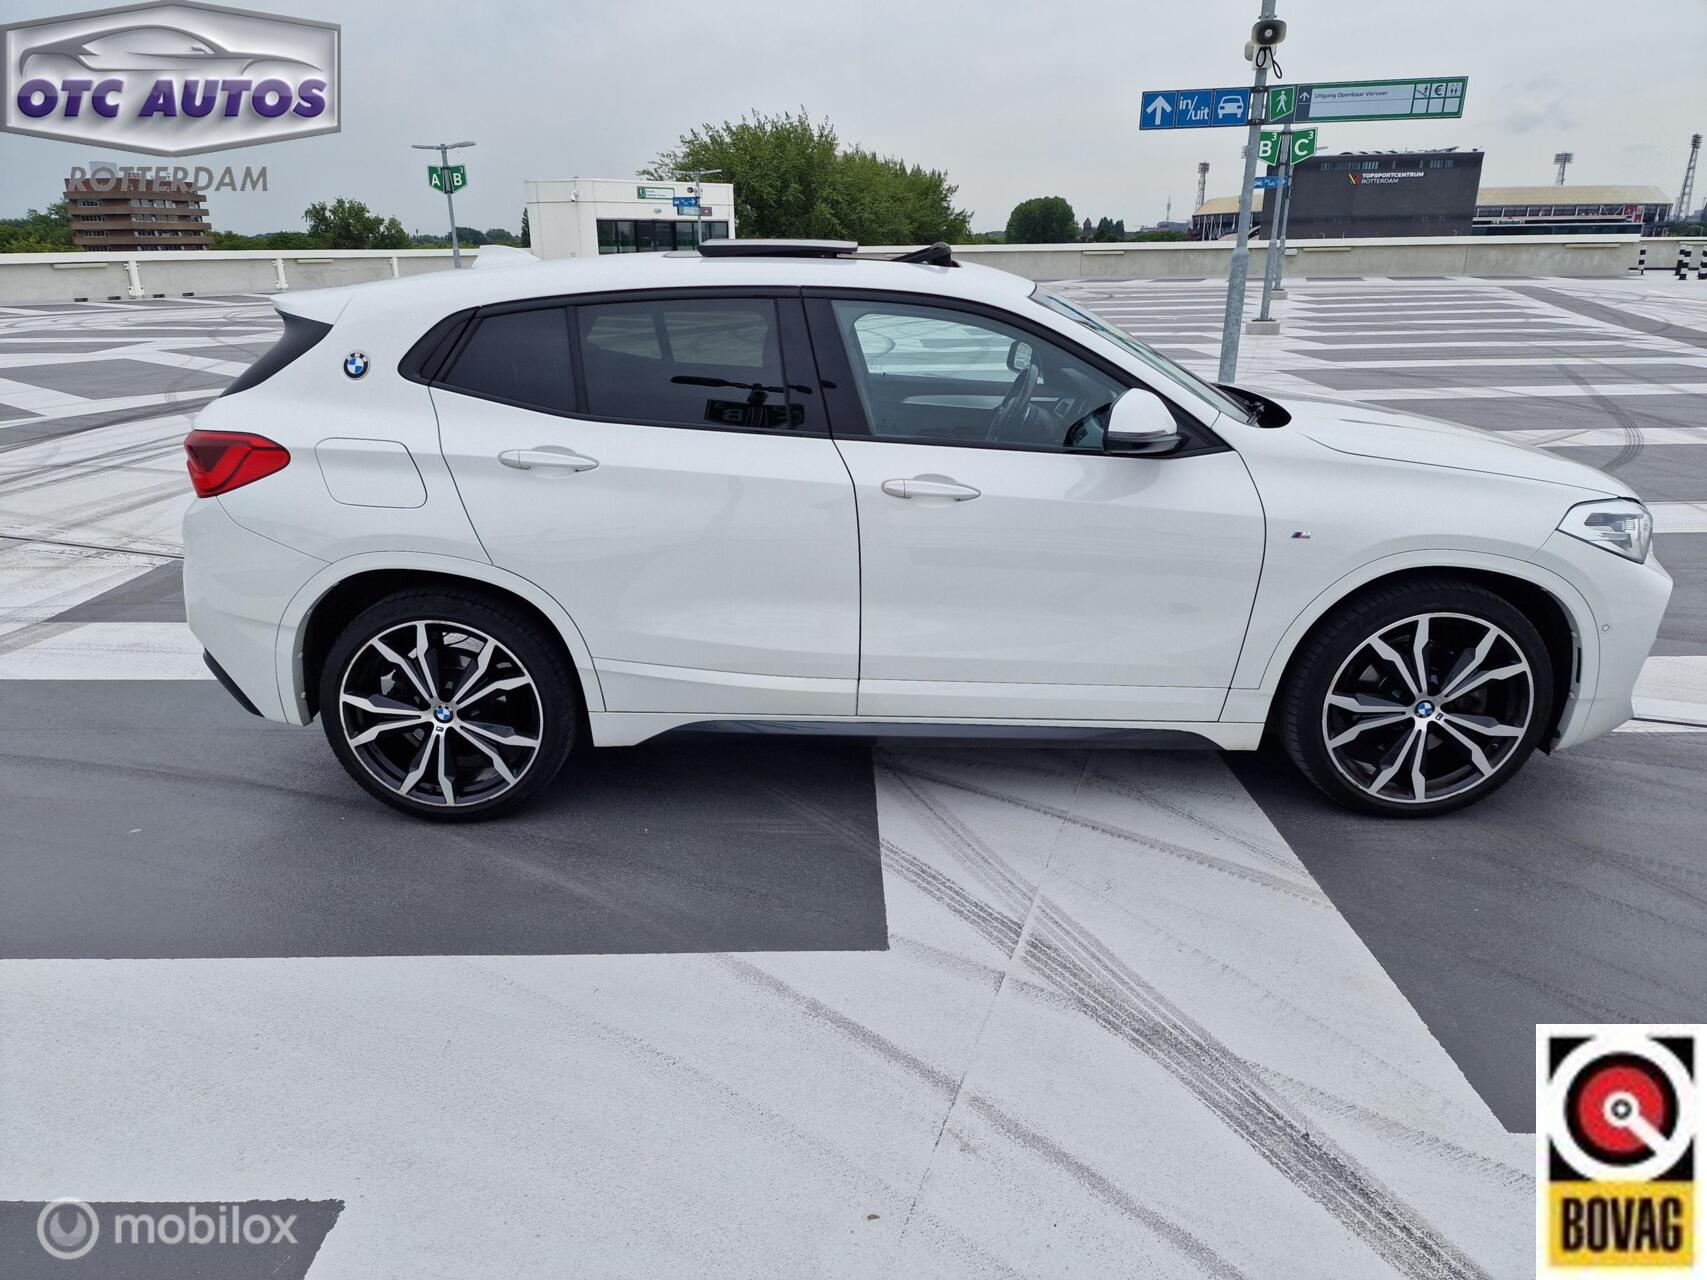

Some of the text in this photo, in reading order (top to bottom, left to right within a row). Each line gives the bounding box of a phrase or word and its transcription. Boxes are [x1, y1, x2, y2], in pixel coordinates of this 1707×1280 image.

[1314, 92, 1337, 100] Uitgang
[1337, 91, 1365, 99] Openbaar
[1258, 140, 1272, 156] B
[1294, 138, 1310, 156] C
[431, 173, 441, 186] A
[453, 173, 462, 186] B
[1362, 171, 1425, 179] TOPSPORTCENTRUM
